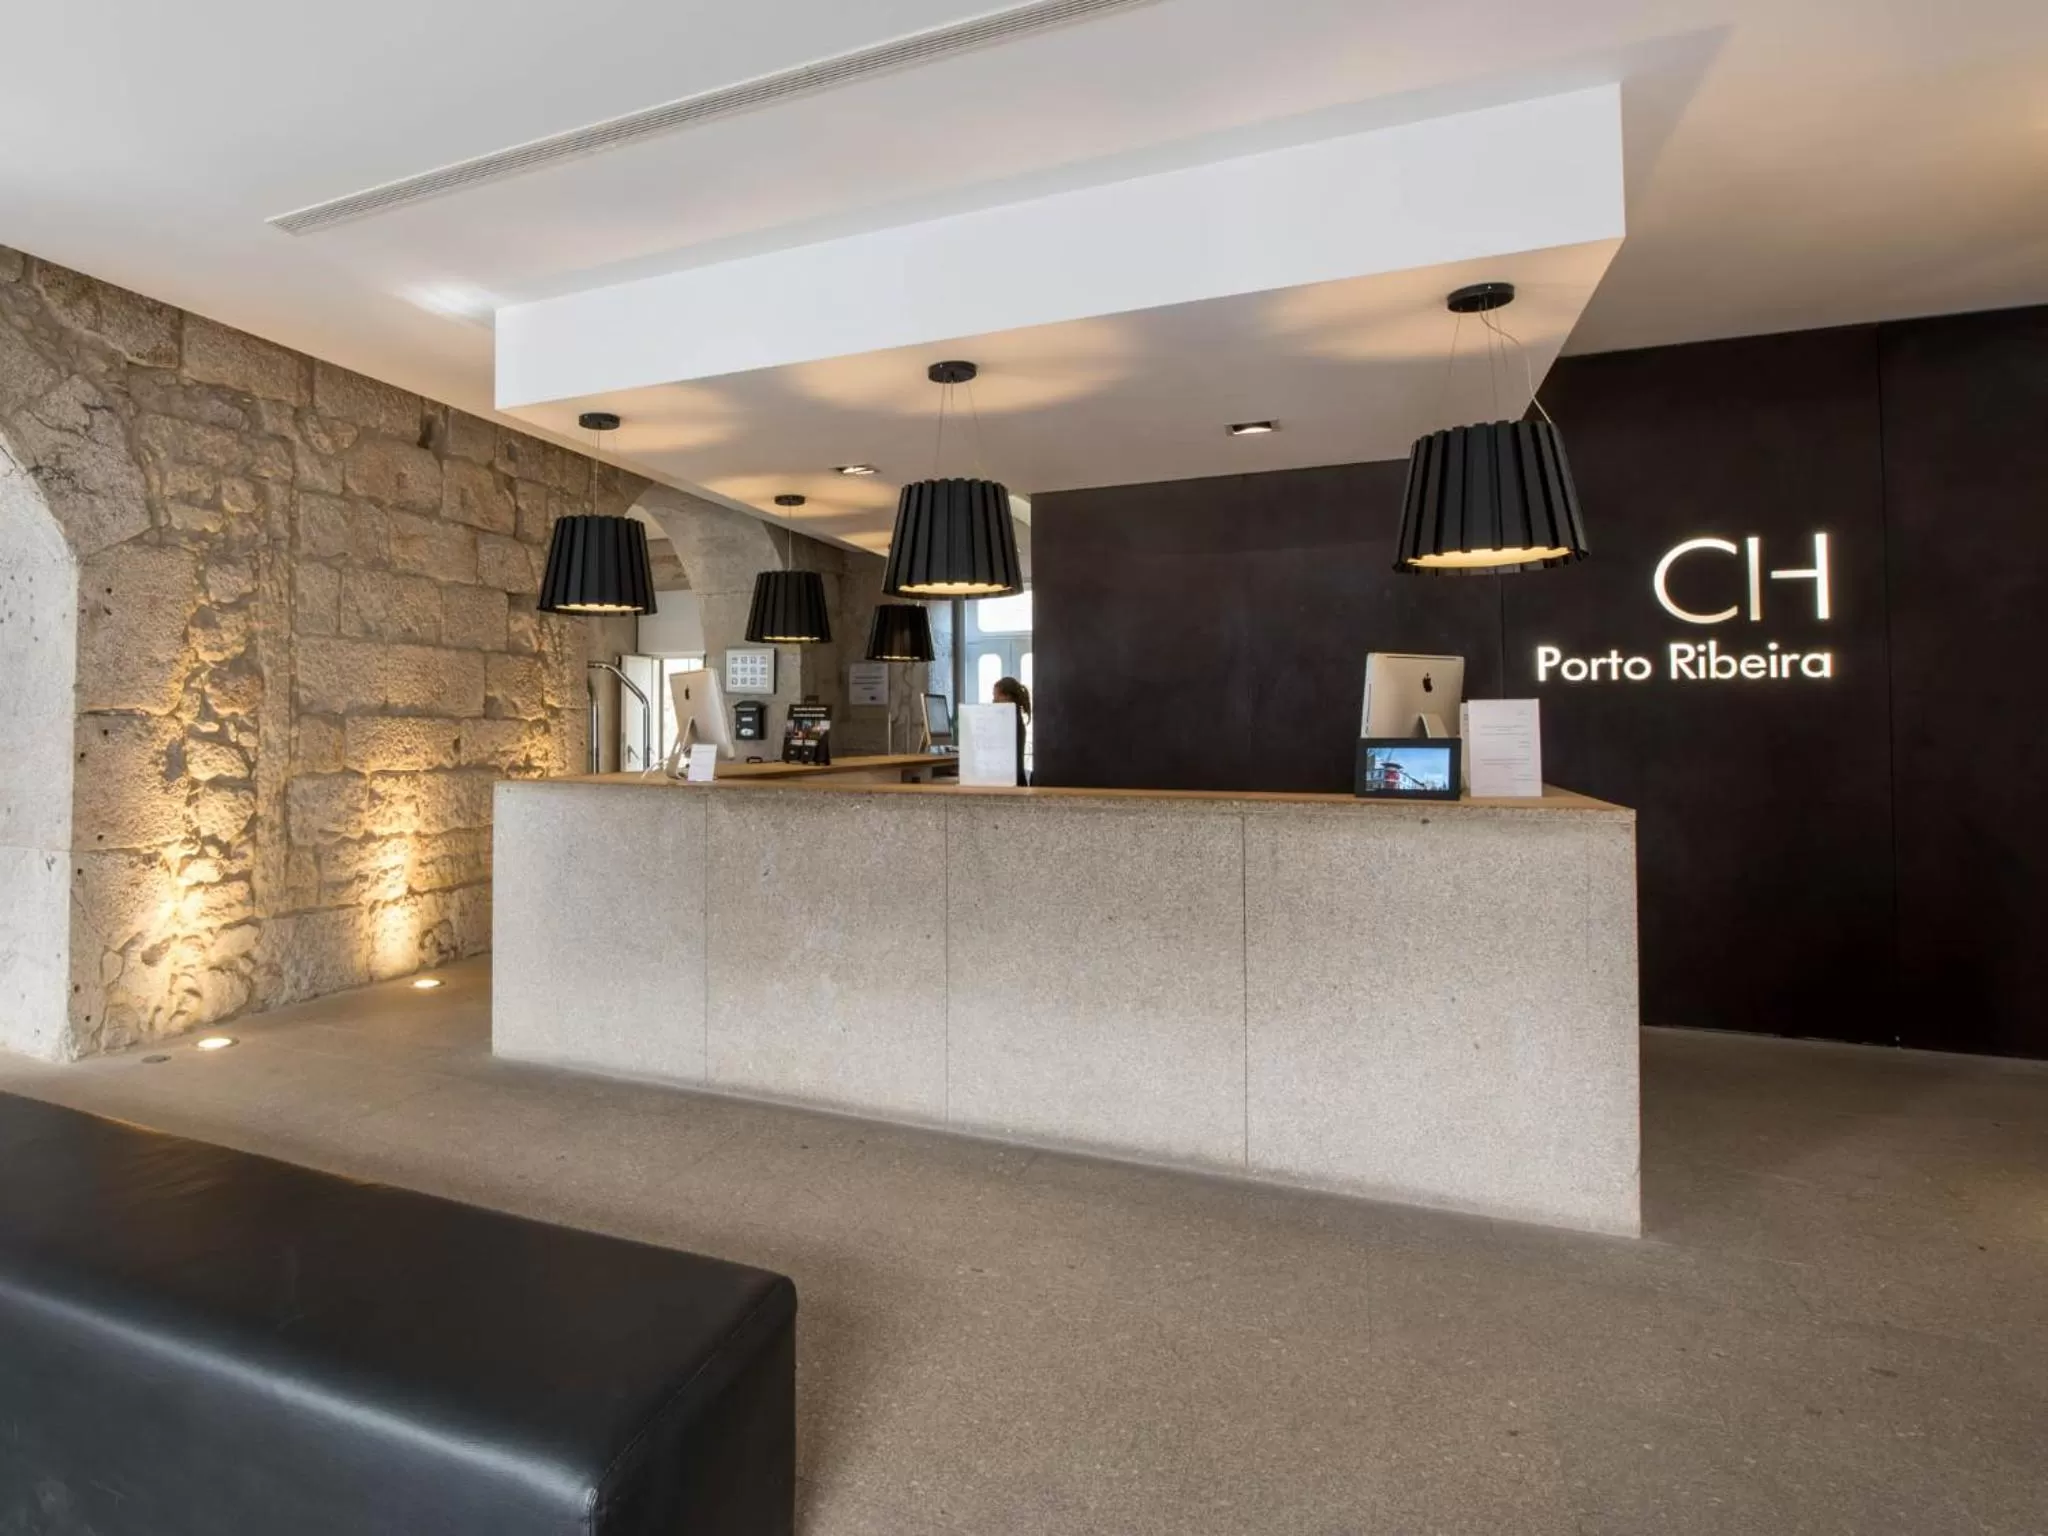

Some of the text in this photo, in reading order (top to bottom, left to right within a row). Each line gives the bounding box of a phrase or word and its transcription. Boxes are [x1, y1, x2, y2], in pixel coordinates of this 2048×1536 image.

[1653, 532, 1831, 624] CH
[1536, 640, 1833, 682] Porto Ribeira
